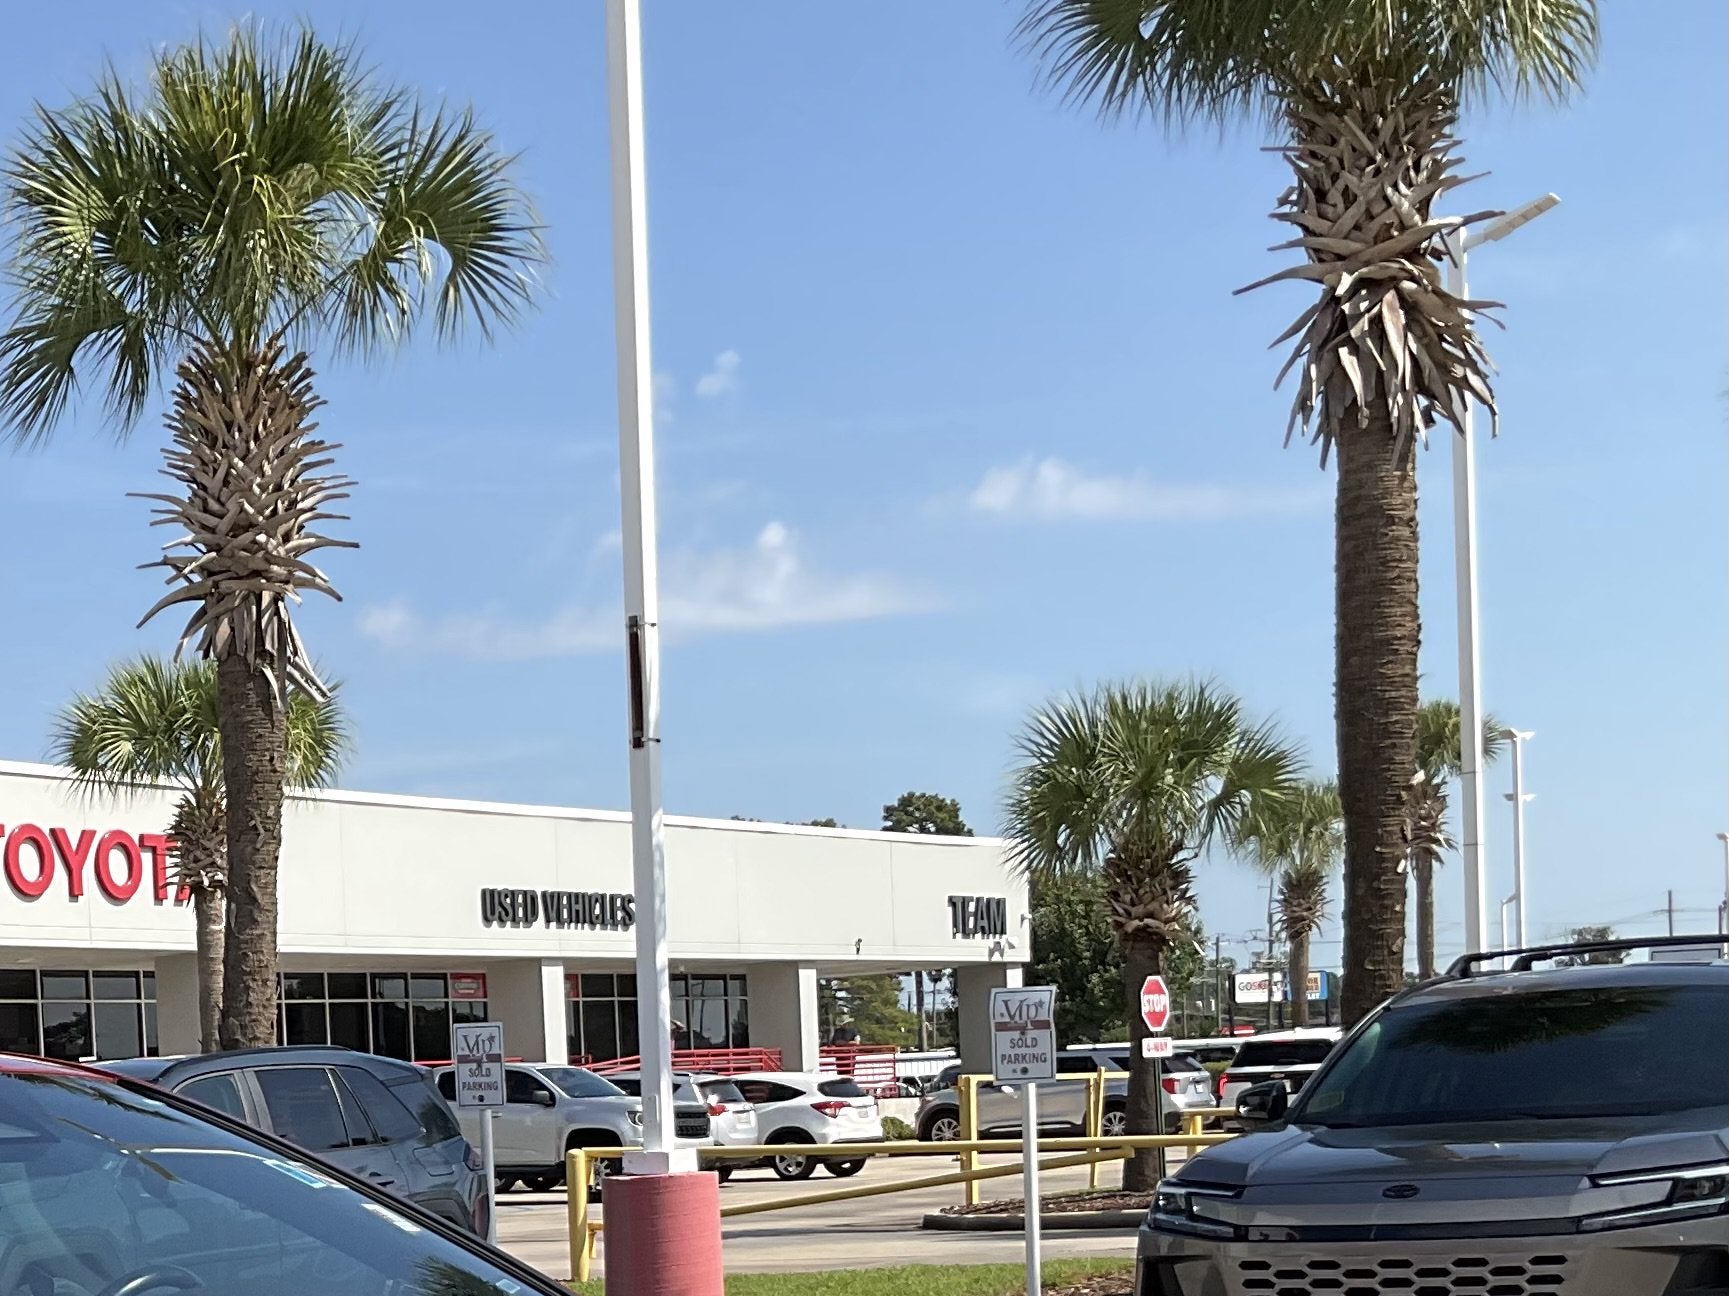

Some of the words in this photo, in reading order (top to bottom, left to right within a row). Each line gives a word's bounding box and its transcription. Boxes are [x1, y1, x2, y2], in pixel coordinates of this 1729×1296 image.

[481, 888, 539, 926] USED
[541, 890, 636, 930] VEHICLES
[948, 895, 1007, 938] TEAM
[1143, 994, 1167, 1013] STOP
[1009, 1036, 1038, 1049] SOLD
[1000, 1052, 1047, 1065] PARKING
[468, 1067, 491, 1078] SOLD
[462, 1080, 498, 1091] PARKING
